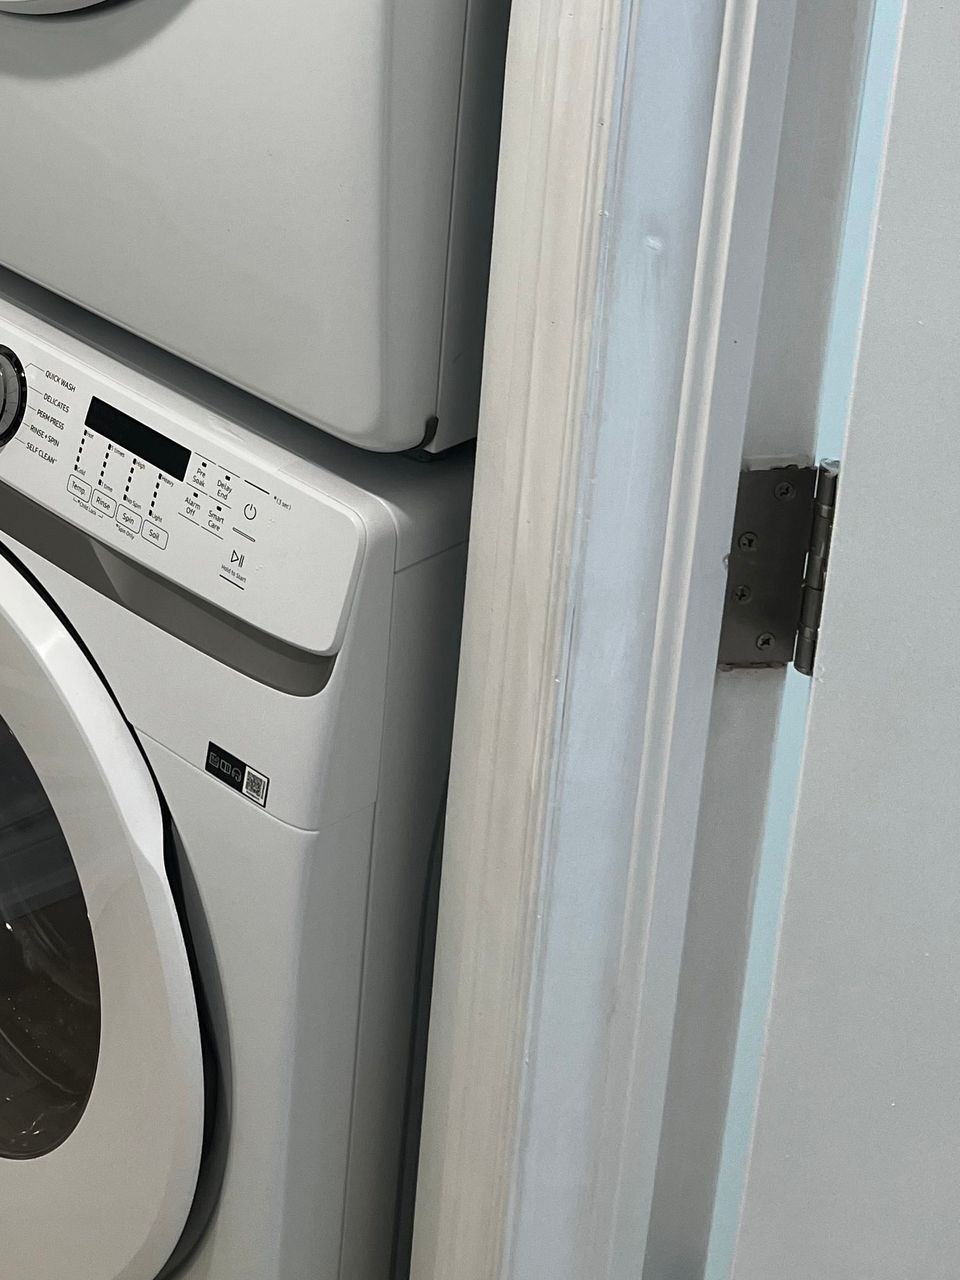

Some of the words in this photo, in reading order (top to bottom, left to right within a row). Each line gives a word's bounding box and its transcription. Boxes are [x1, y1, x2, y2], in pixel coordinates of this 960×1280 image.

[45, 370, 60, 384] QUICK
[60, 378, 76, 392] WASH
[44, 393, 70, 414] DELICATES
[36, 408, 51, 422] PERM
[50, 416, 65, 430] PRESS
[30, 424, 44, 438] RINSE
[48, 434, 60, 448] SPIN
[26, 442, 40, 456] SELF
[197, 468, 206, 478] Pre
[192, 476, 205, 488] Soak
[217, 480, 232, 494] Delay
[216, 490, 228, 500] End
[96, 496, 111, 510] Rinse
[184, 496, 200, 510] Alarm
[186, 506, 196, 516] Off
[208, 510, 224, 524] Smart
[122, 512, 134, 525] Spin
[208, 520, 220, 532] Care
[148, 528, 160, 540] Soil
[221, 564, 232, 574] Hold
[236, 572, 246, 583] Start
